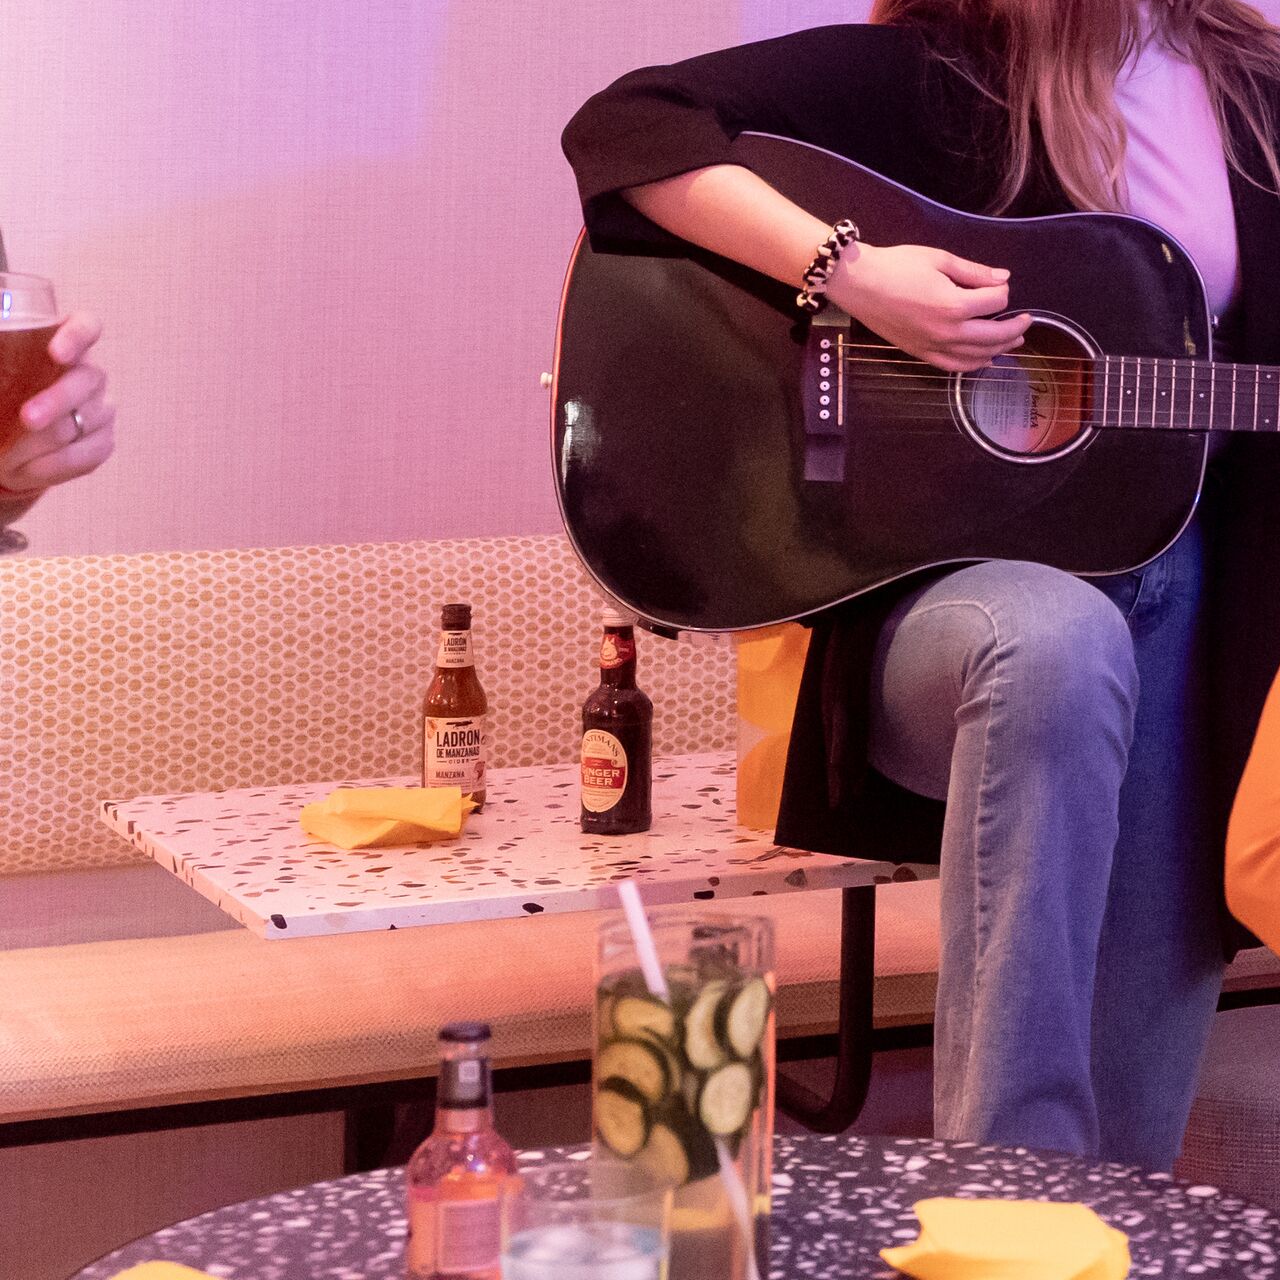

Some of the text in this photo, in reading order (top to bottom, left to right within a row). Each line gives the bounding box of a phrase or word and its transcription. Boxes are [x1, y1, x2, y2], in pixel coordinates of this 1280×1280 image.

[436, 746, 480, 759] DE MANZANAS
[583, 774, 613, 786] BEER
